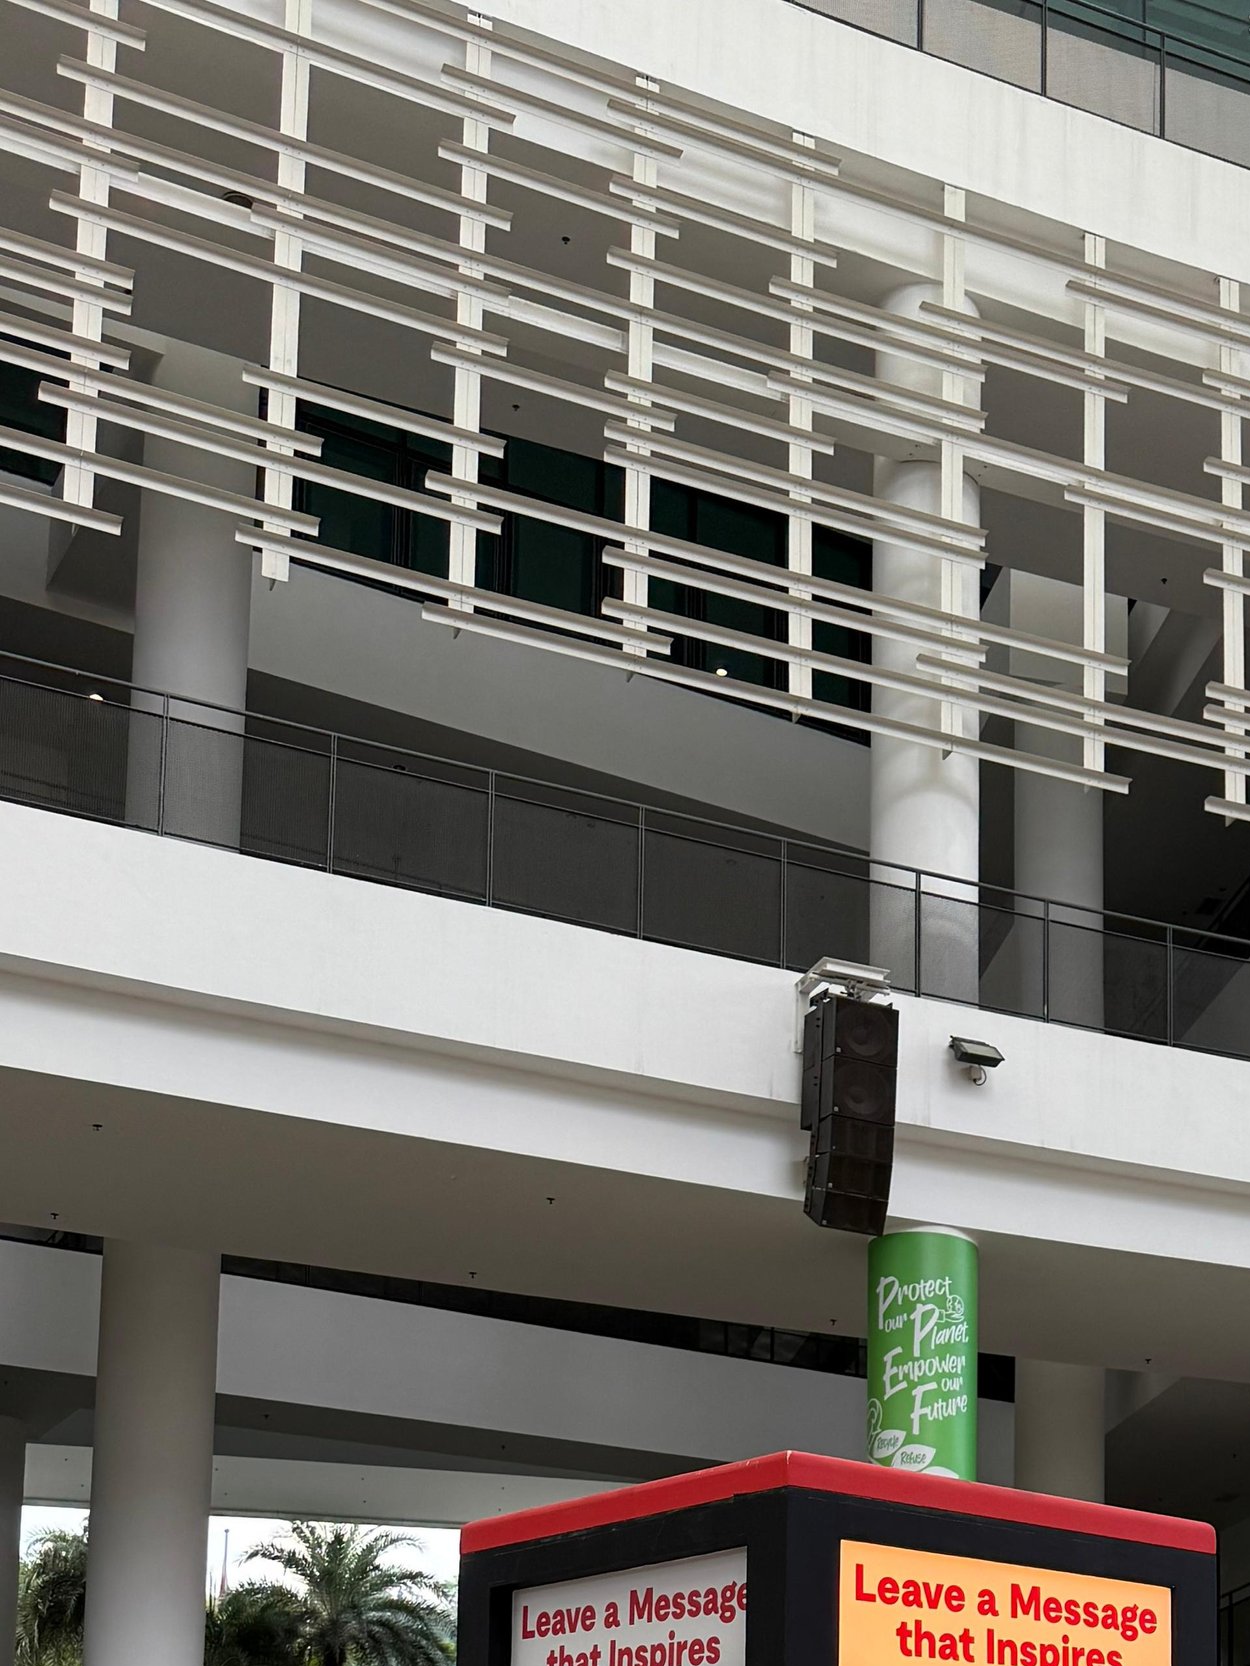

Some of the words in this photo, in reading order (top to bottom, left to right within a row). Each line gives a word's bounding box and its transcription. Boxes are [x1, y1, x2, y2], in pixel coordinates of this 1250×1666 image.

[876, 1276, 952, 1329] Protect
[885, 1313, 908, 1333] our
[883, 1346, 965, 1400] Empower
[941, 1376, 963, 1391] our
[911, 1382, 968, 1435] Future
[521, 1604, 597, 1639] Leave
[603, 1601, 620, 1629] a
[628, 1580, 747, 1624] Message
[855, 1563, 966, 1613] Leave
[977, 1588, 999, 1617] a
[1010, 1583, 1158, 1642] Message
[896, 1619, 975, 1663] that
